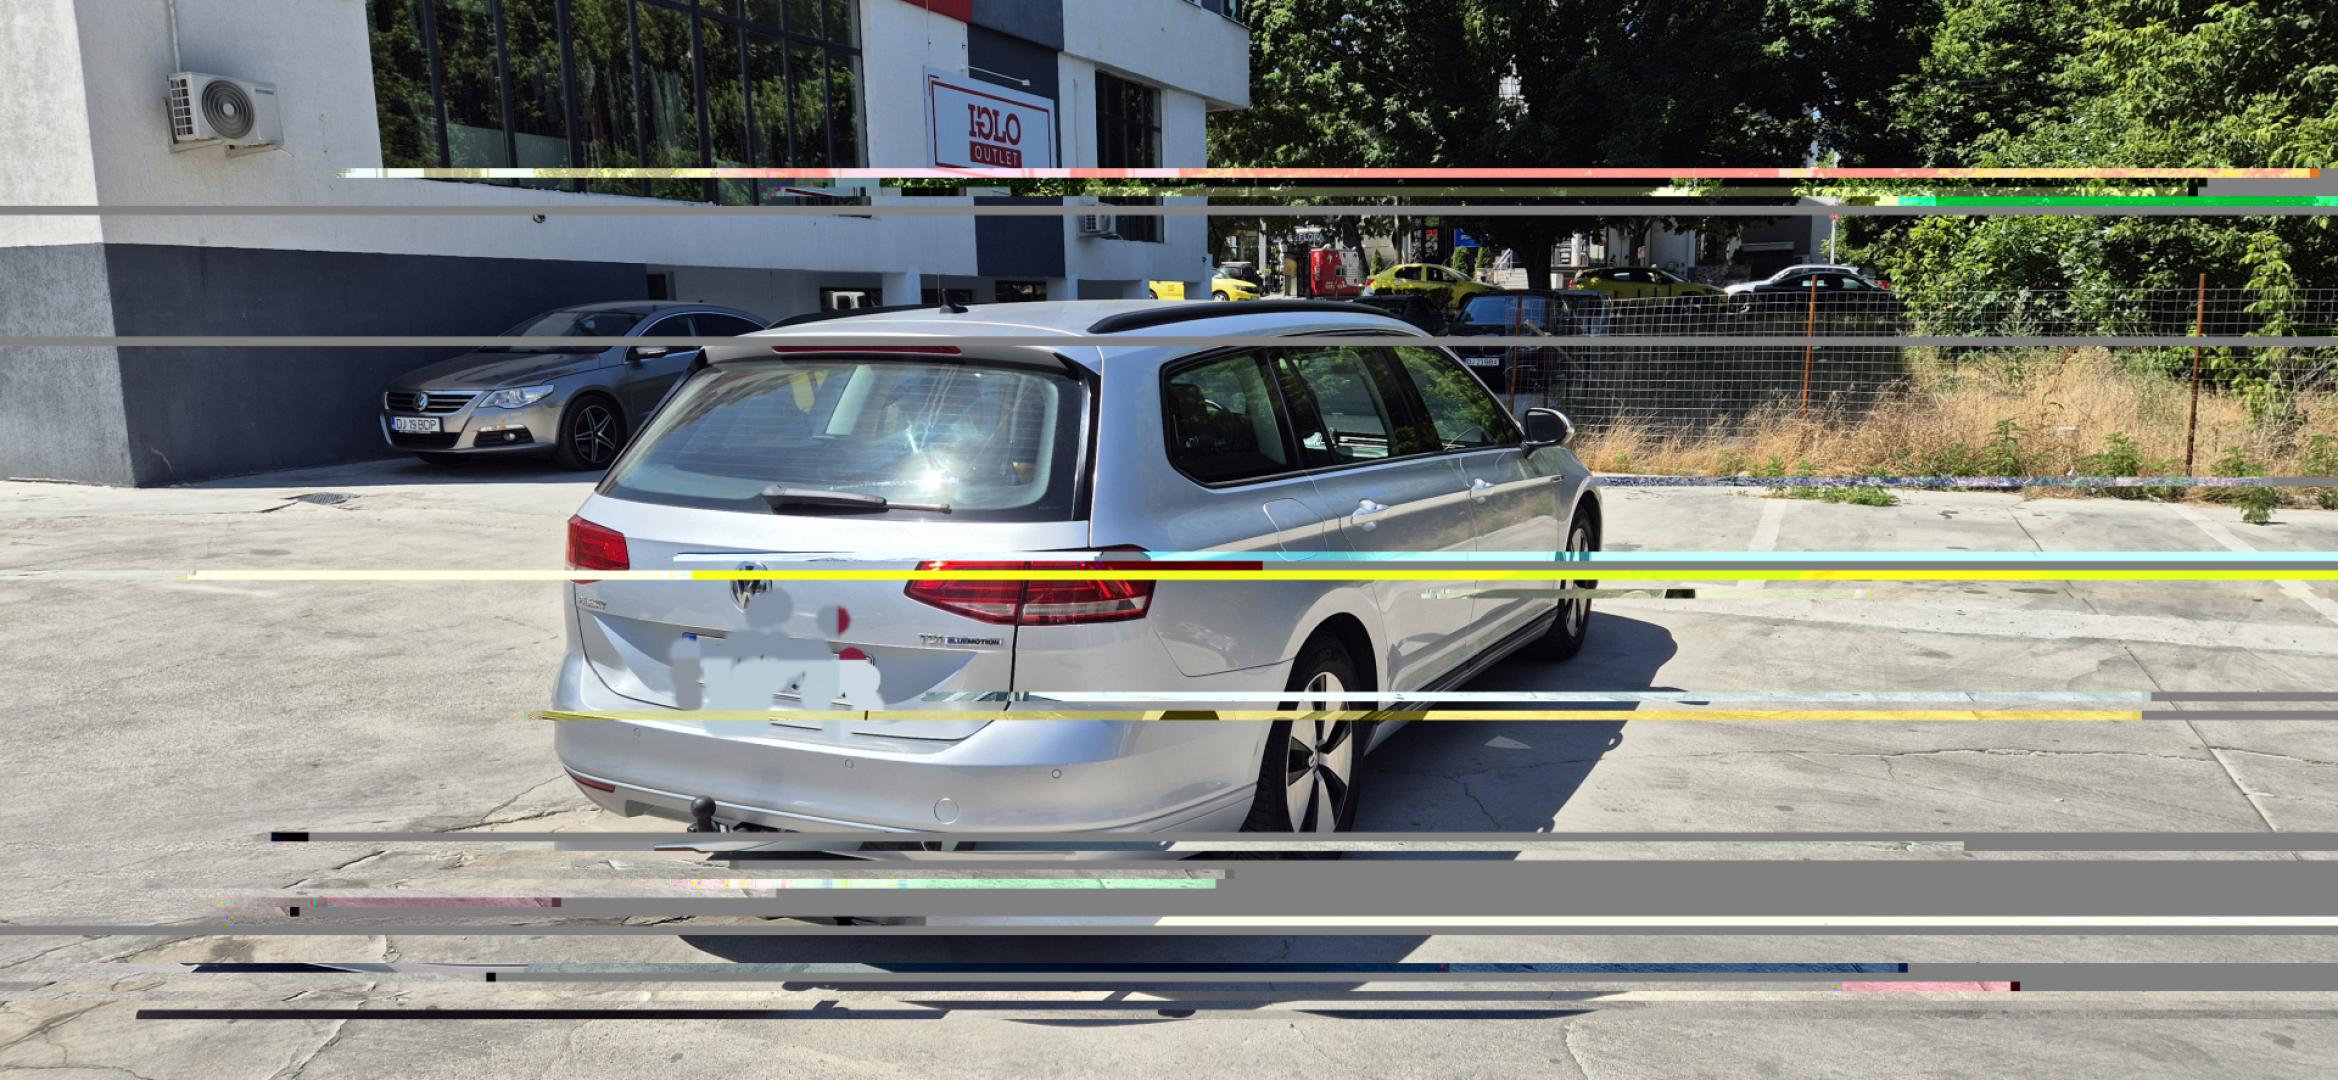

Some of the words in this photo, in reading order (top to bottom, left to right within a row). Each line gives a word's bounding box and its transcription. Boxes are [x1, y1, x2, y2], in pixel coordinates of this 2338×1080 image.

[968, 103, 1021, 145] IGLO
[974, 145, 1018, 165] OUTLET
[396, 418, 406, 430] DJ
